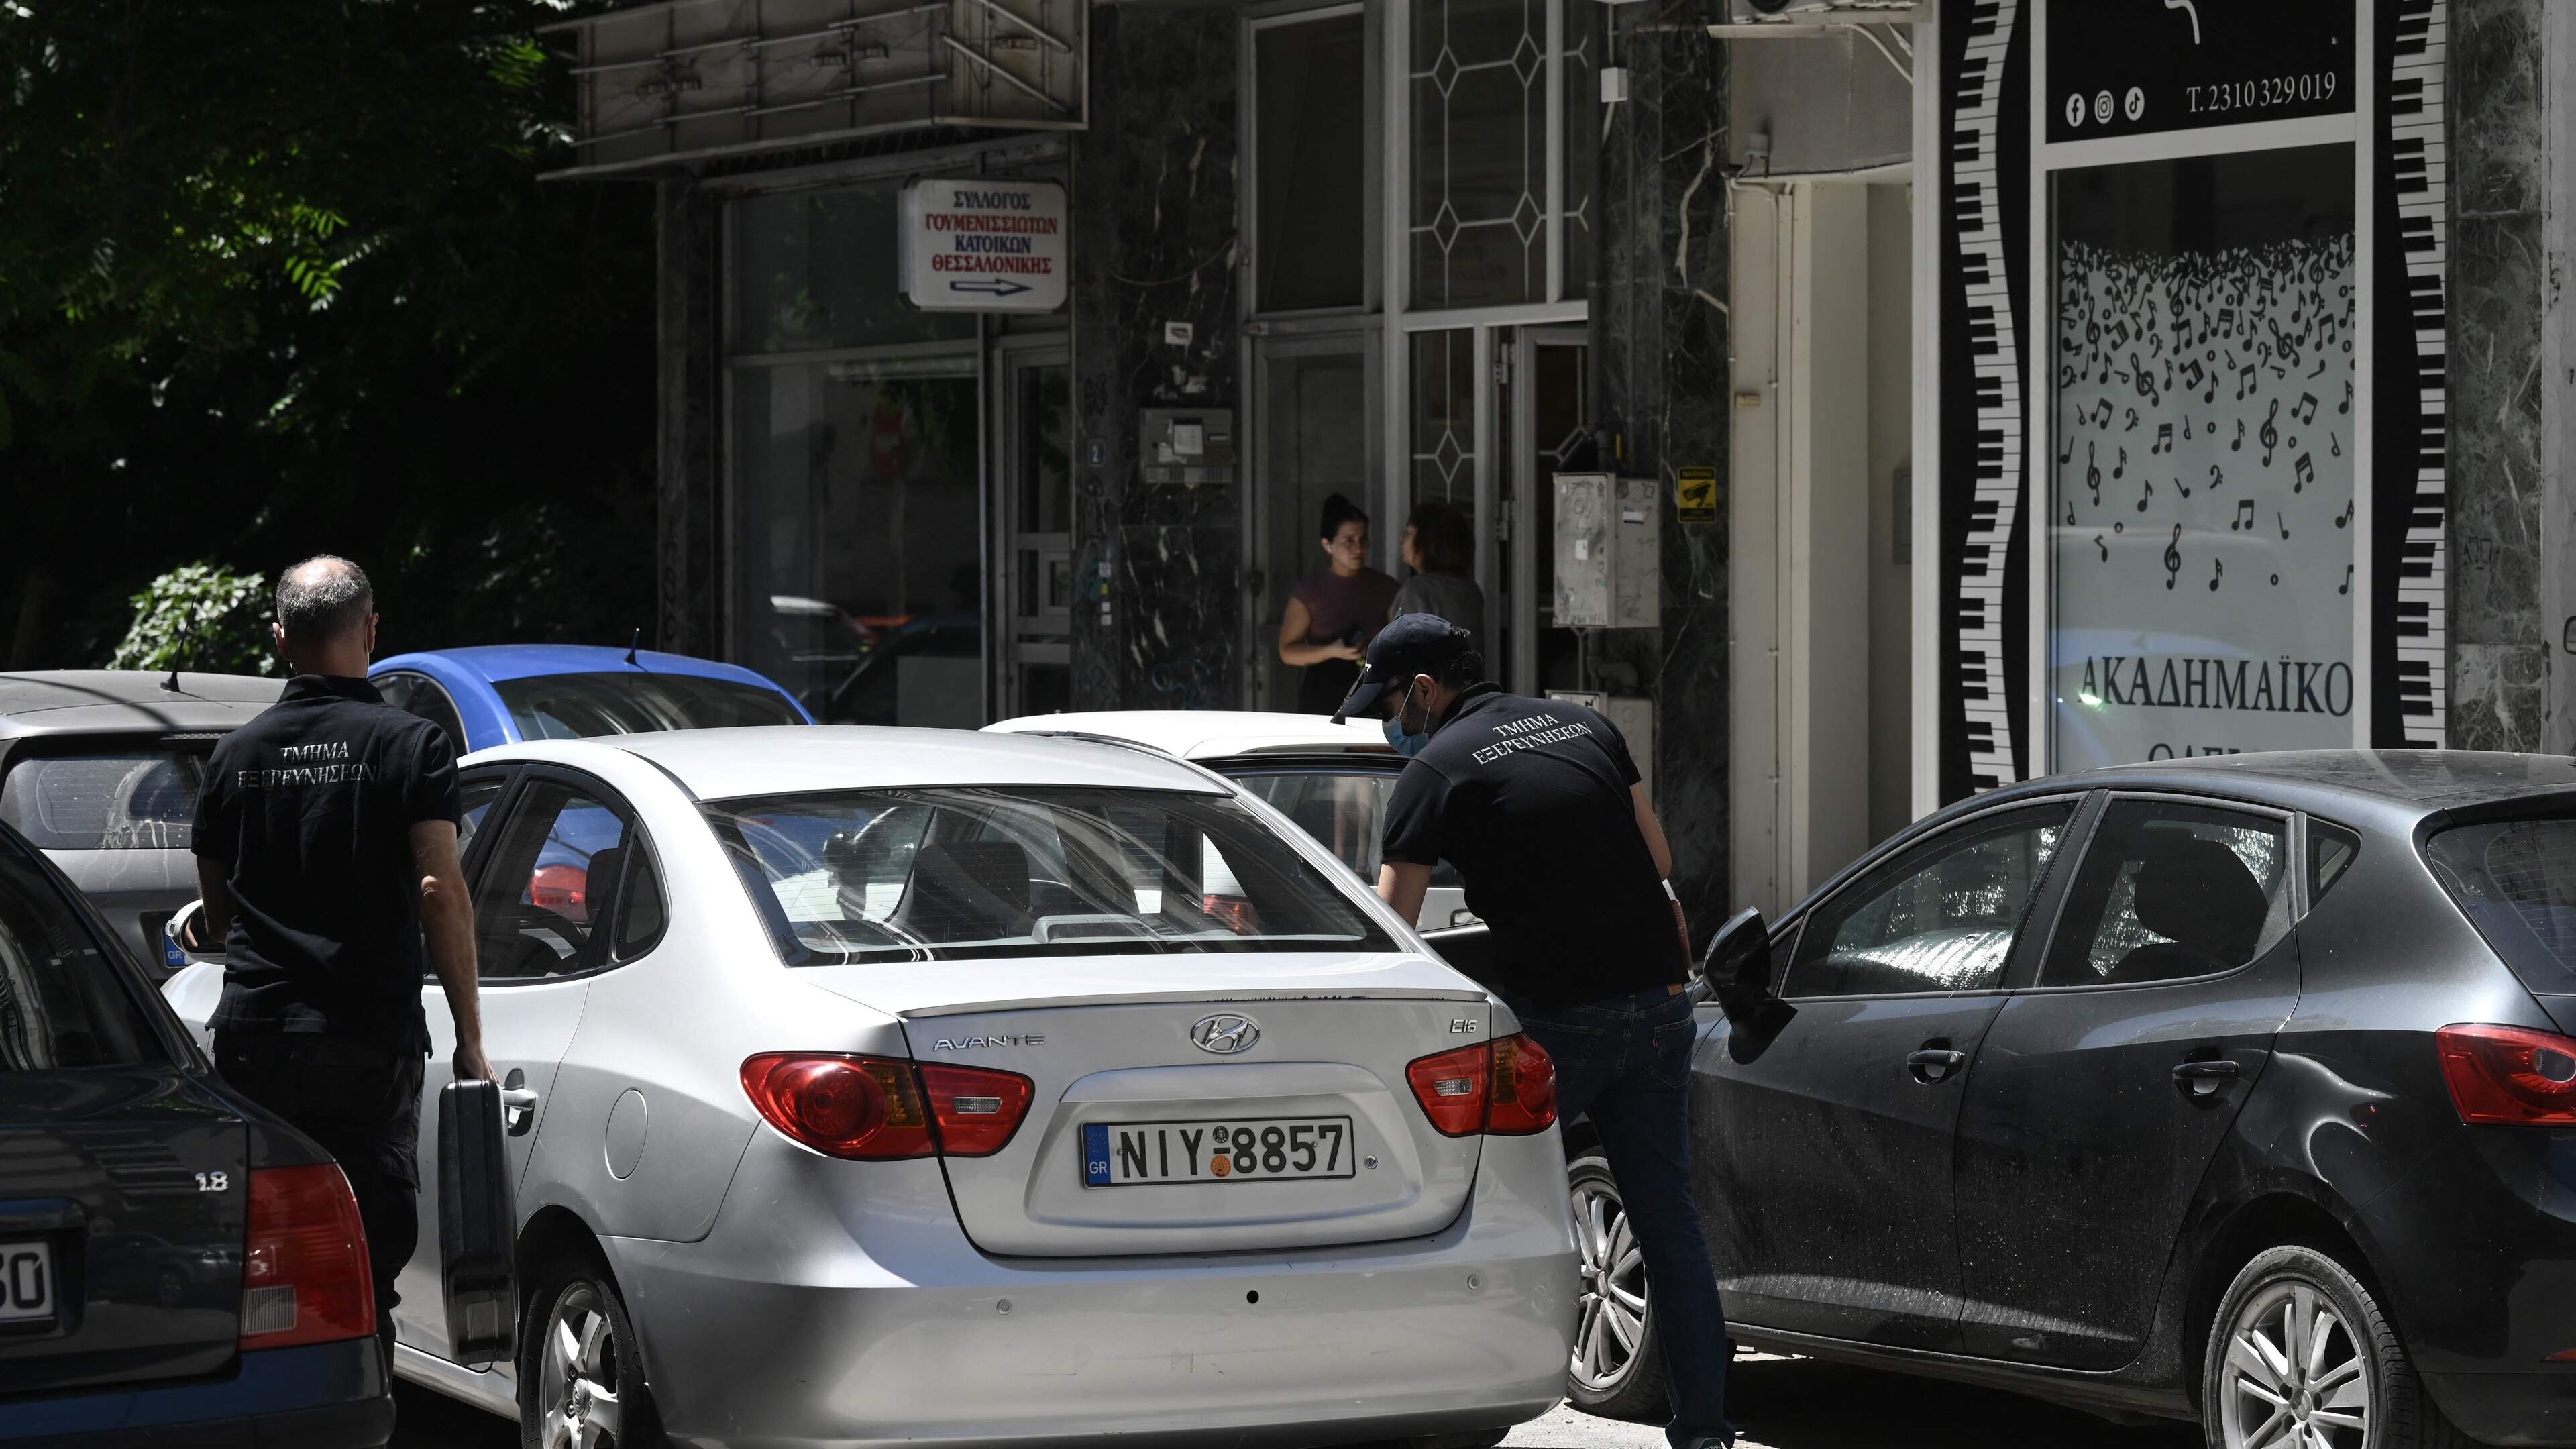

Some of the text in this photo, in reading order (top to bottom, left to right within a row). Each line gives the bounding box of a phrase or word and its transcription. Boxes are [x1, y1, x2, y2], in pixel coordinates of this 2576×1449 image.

[2208, 80, 2256, 112] 2310
[2259, 76, 2296, 107] 329
[2299, 71, 2337, 102] 019
[953, 191, 1031, 210] ΣΥΛΛΟΓΟΣ
[925, 213, 1058, 234] ΓΟΥΜΕΝΙΣΣΙΩΤΩΝ
[955, 235, 1032, 254] ΚΑΤΟΙΚΩΝ
[932, 254, 1051, 274] ΘΕΣΣΑΛΟΝΙΚΗΣ
[2078, 655, 2354, 717] ΑΚΑΔΗΜΑΪΚΟ
[1491, 714, 1560, 737] ΤΜΗΜΑ
[280, 741, 350, 763] ΤΜΗΜΑ
[1471, 721, 1593, 765] ΕΞΕΡΕΥΝΗΣΕΩΝ
[237, 762, 378, 789] ΕΞΕΡΕΥΝΗΣΕΩΝ
[167, 950, 183, 959] GR
[933, 1032, 1046, 1051] AVANTE
[1089, 1161, 1108, 1175] GR
[0, 1252, 45, 1310] 0
